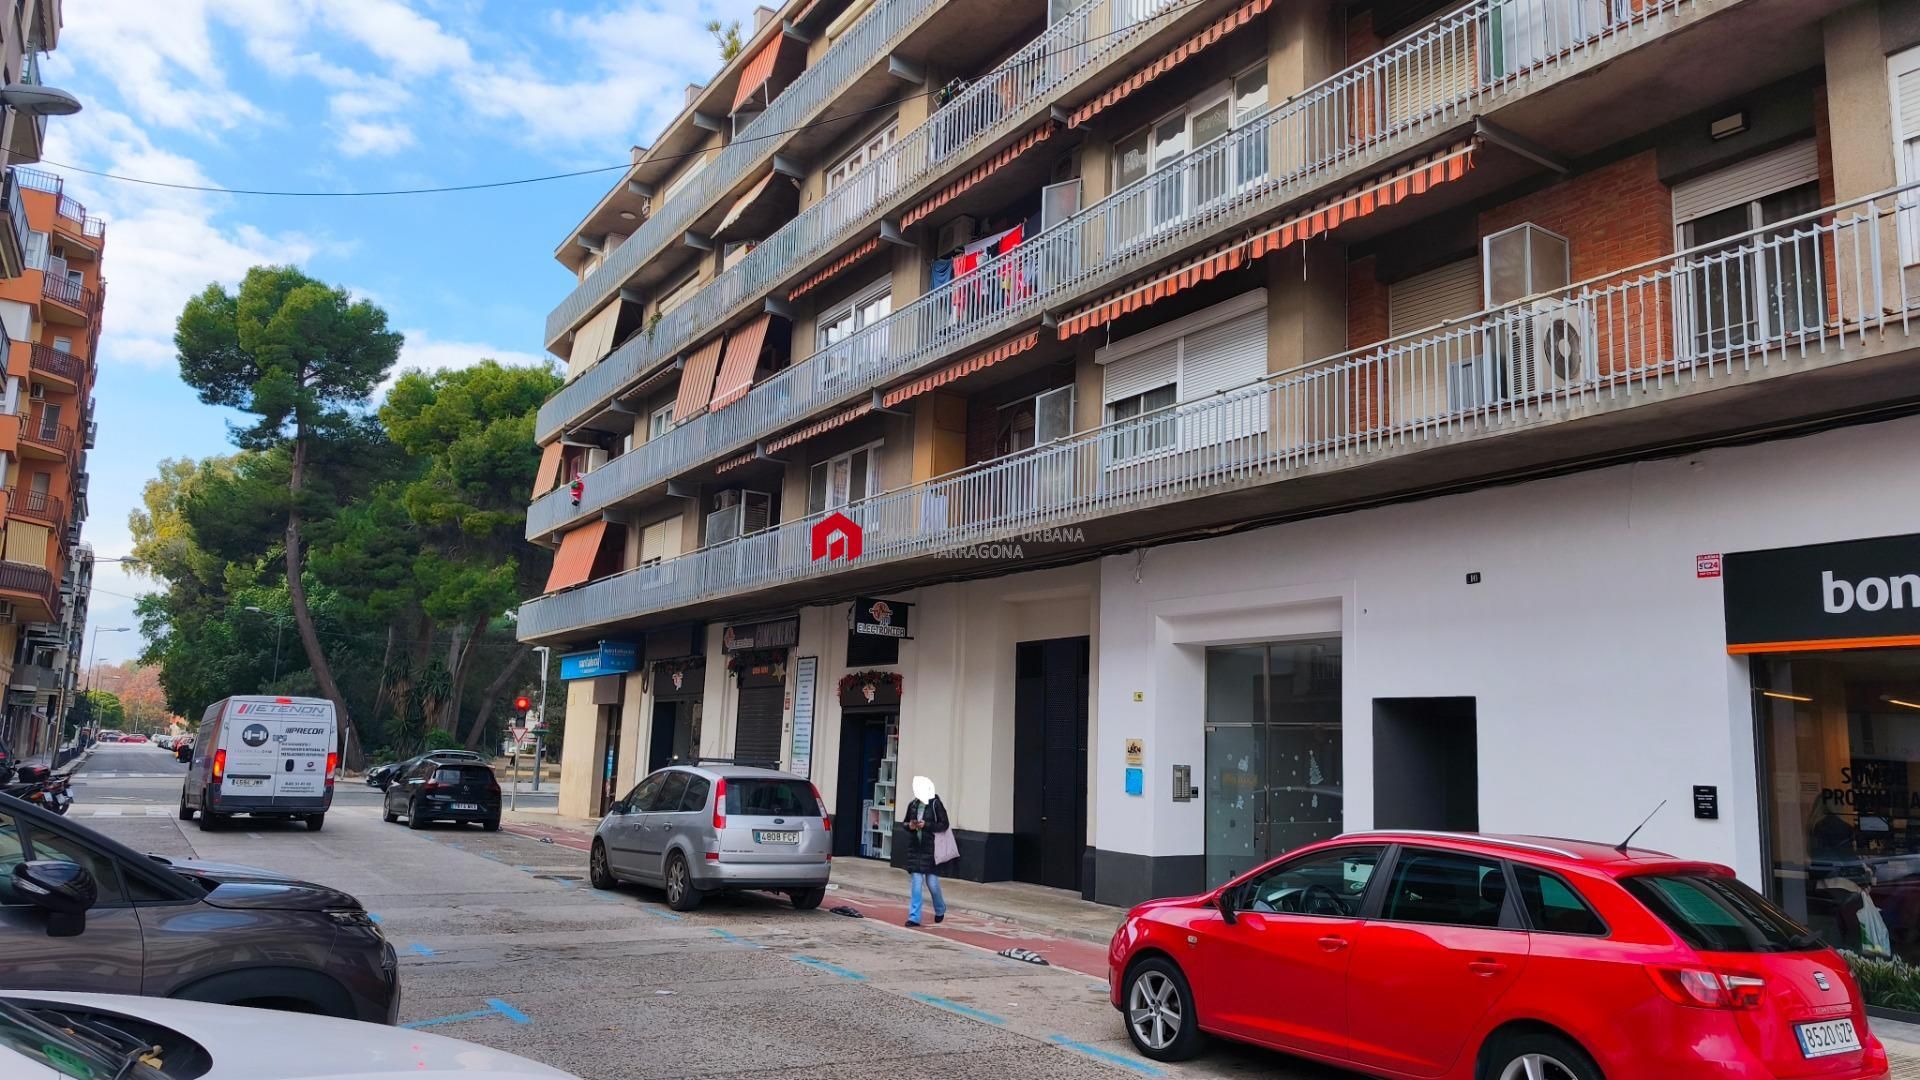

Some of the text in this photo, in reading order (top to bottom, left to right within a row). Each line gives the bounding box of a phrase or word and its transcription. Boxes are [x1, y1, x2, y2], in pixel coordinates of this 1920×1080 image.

[761, 831, 796, 842] 4808 FCF
[1805, 1022, 1853, 1049] 8520 GZP
